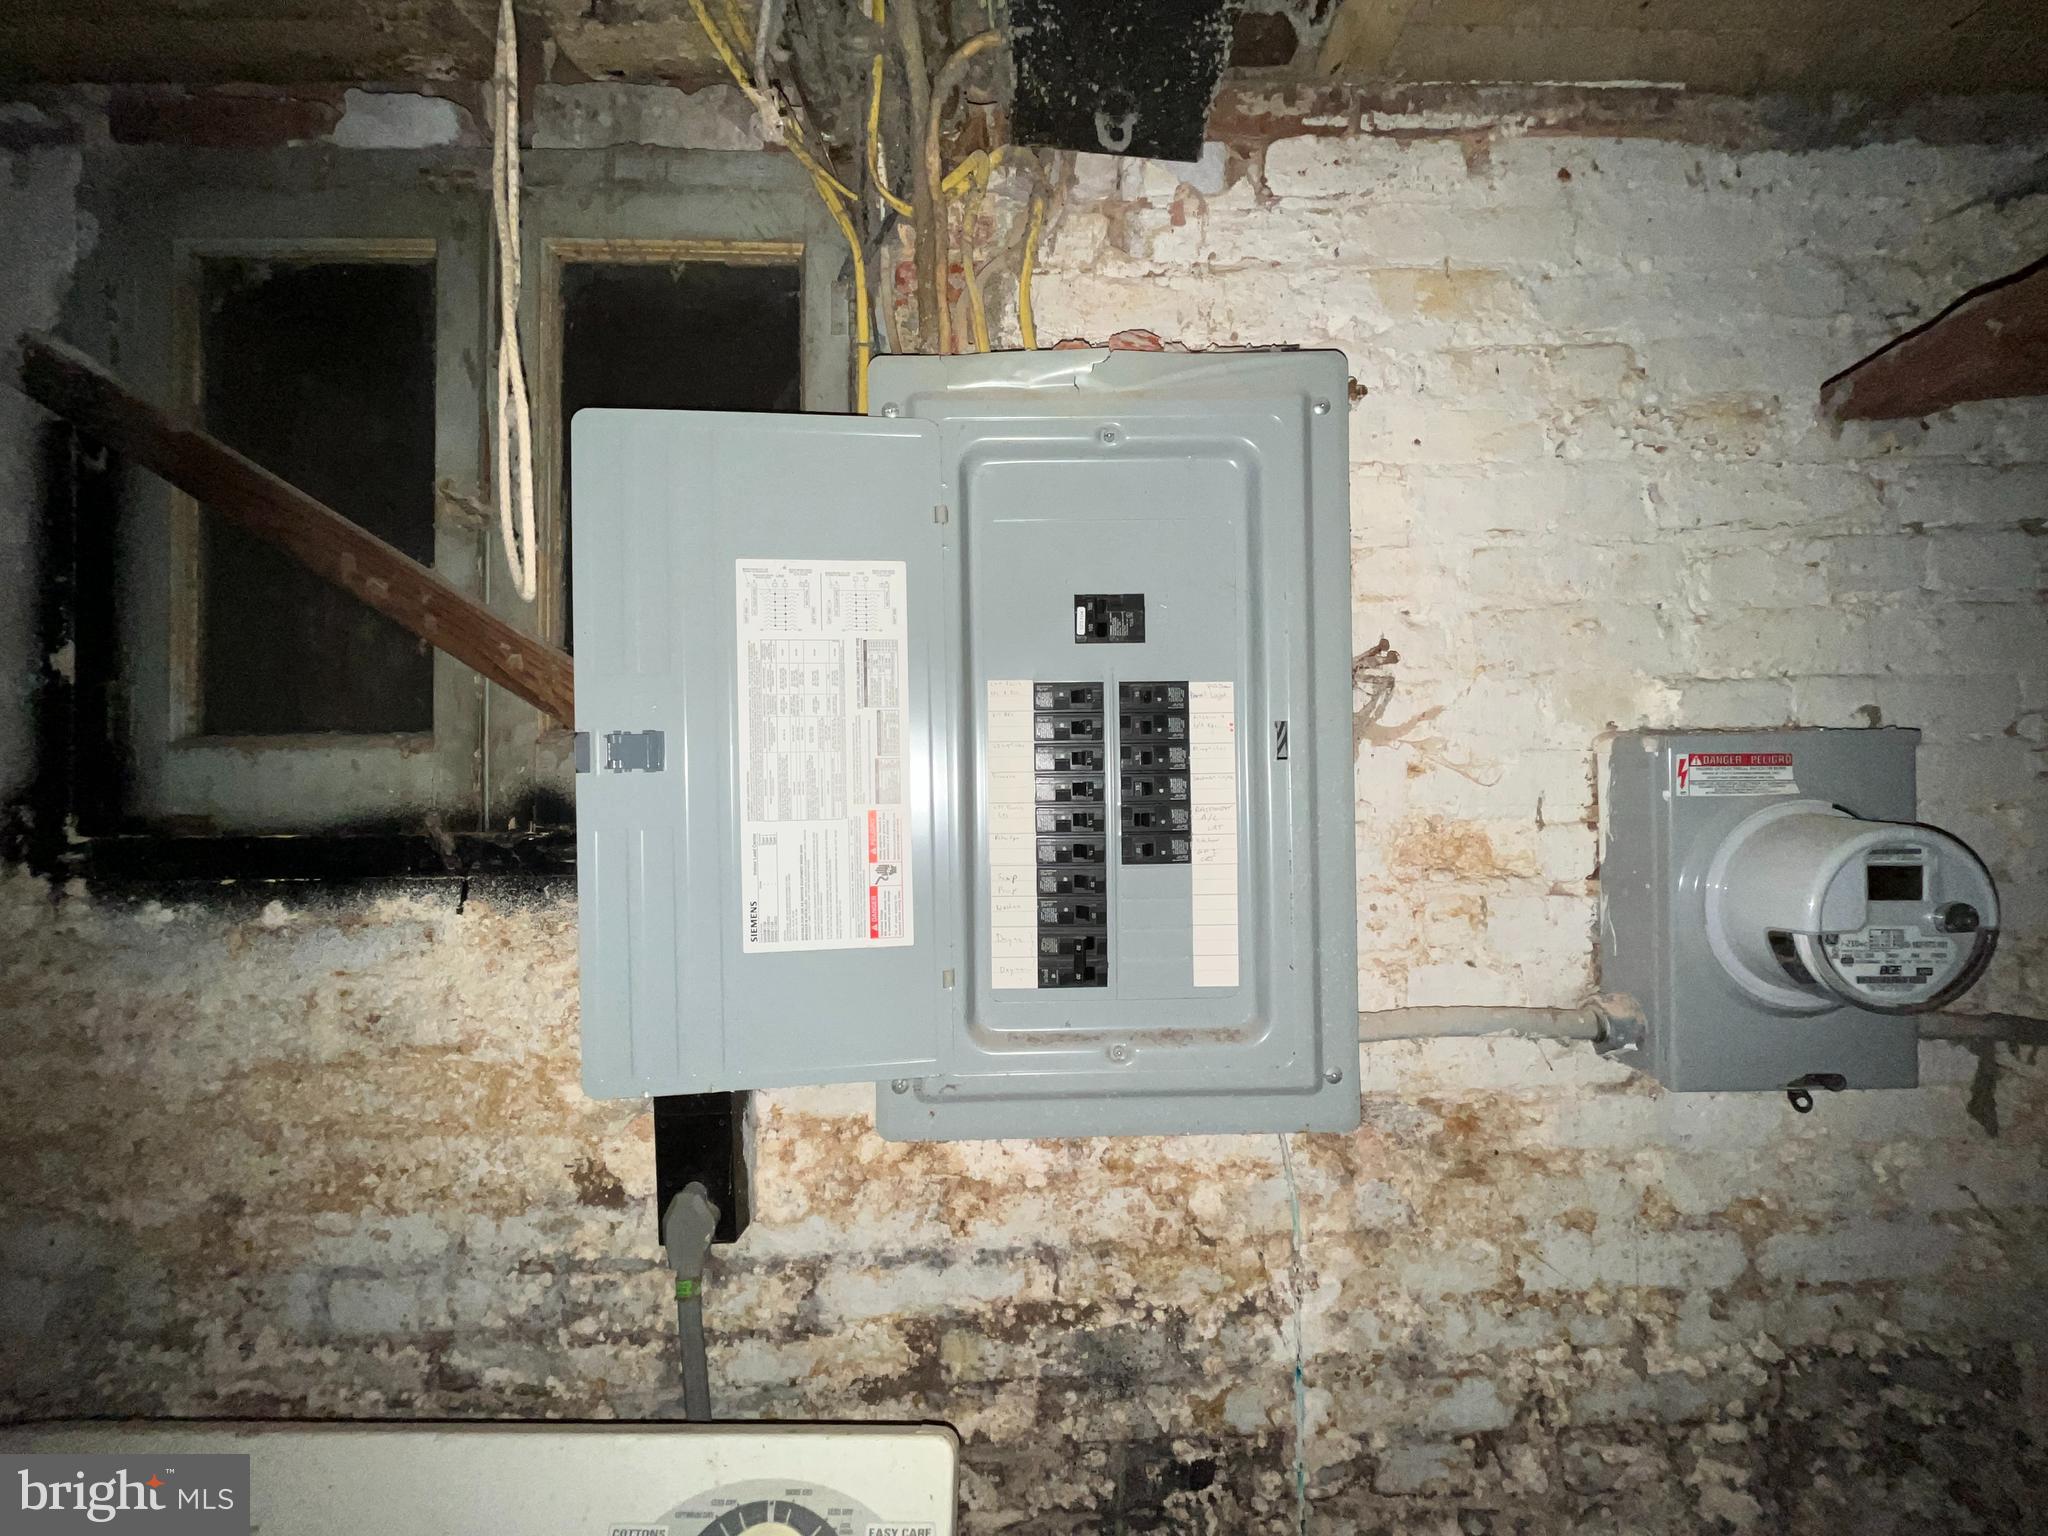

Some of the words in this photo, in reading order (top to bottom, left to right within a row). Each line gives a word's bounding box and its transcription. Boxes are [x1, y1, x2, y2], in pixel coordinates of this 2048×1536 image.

[1703, 755, 1742, 765] DANGER
[1751, 754, 1792, 765] PELIGRO
[750, 901, 758, 943] SIEMENS
[611, 1528, 666, 1536] COTTONS
[868, 1527, 898, 1536] EASY
[902, 1527, 931, 1536] CARE
